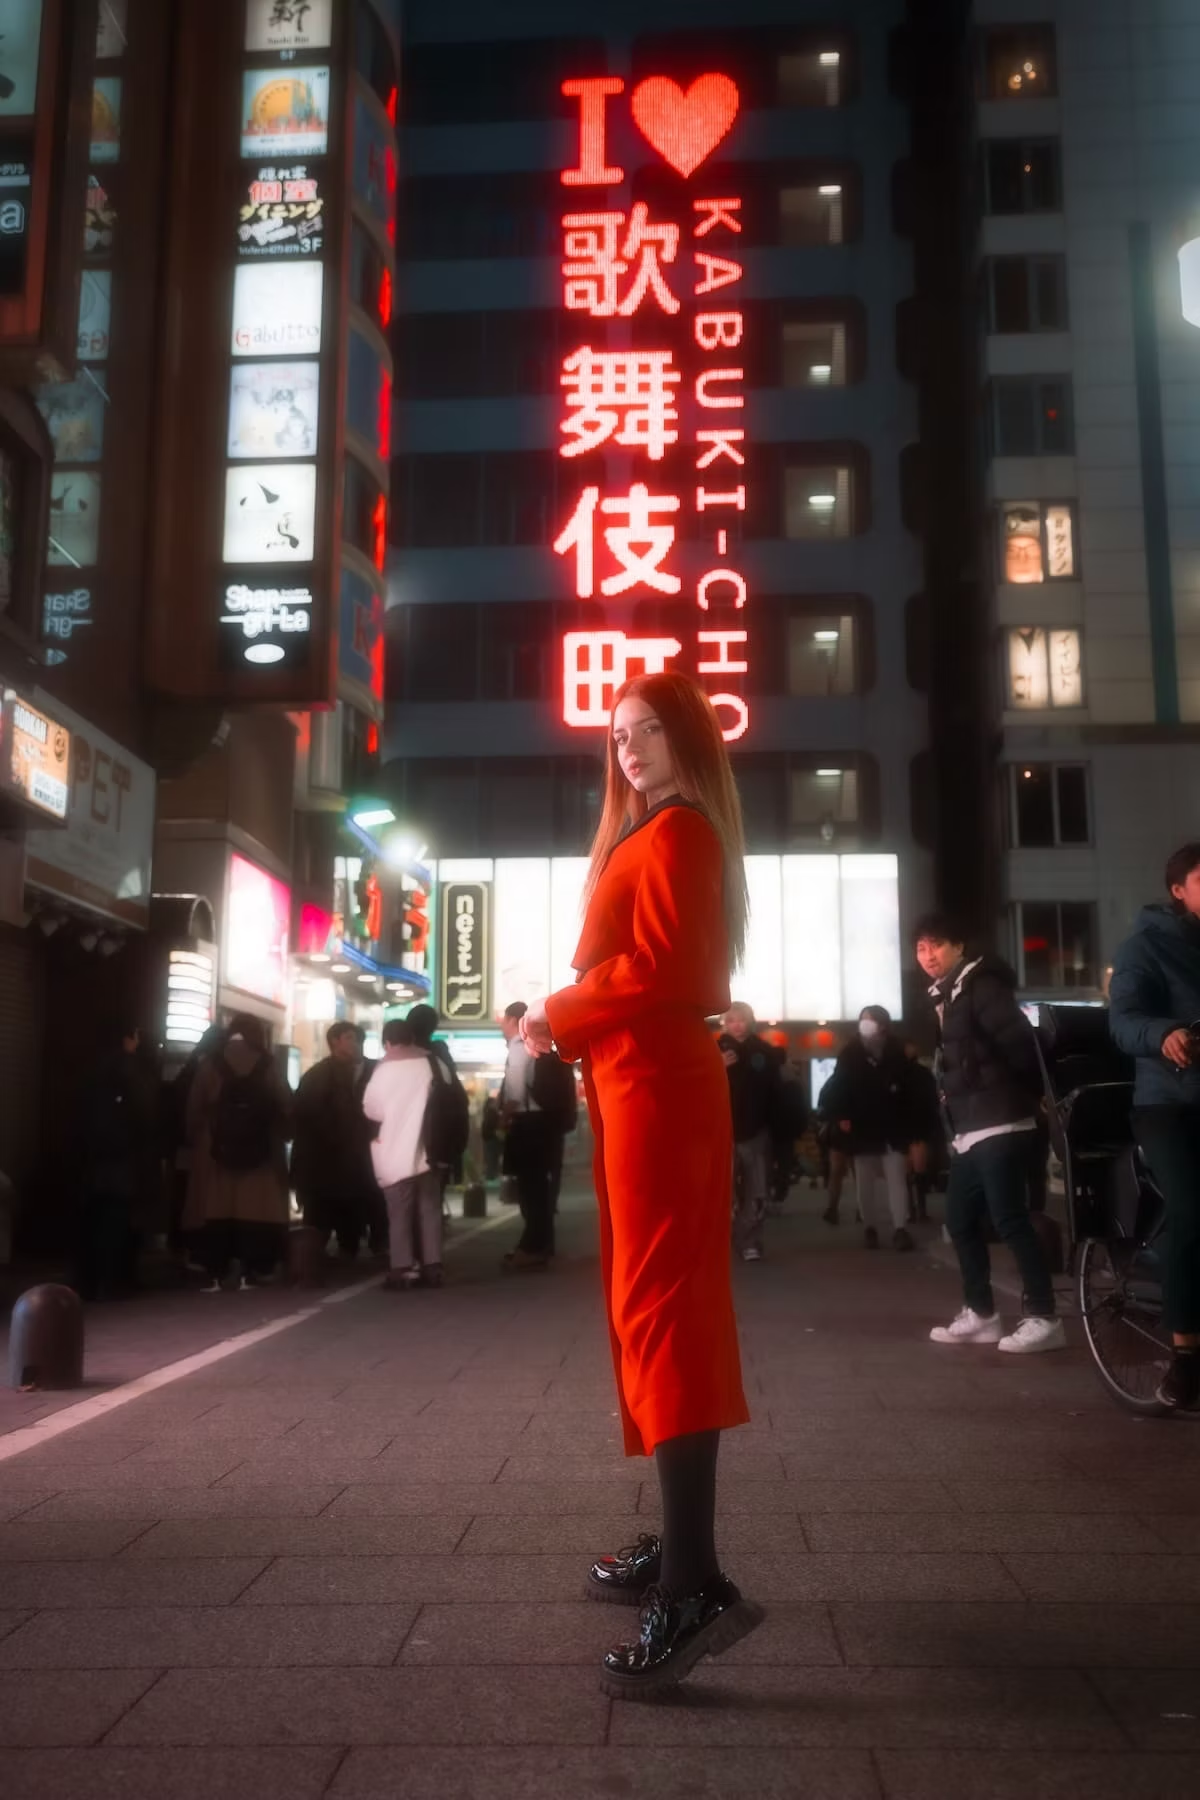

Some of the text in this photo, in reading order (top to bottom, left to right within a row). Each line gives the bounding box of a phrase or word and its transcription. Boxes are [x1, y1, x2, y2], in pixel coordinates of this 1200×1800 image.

[300, 237, 323, 254] 3F
[560, 77, 625, 186] I
[553, 200, 682, 728] 歌舞伎町
[693, 197, 749, 742] KABUKI-CHO
